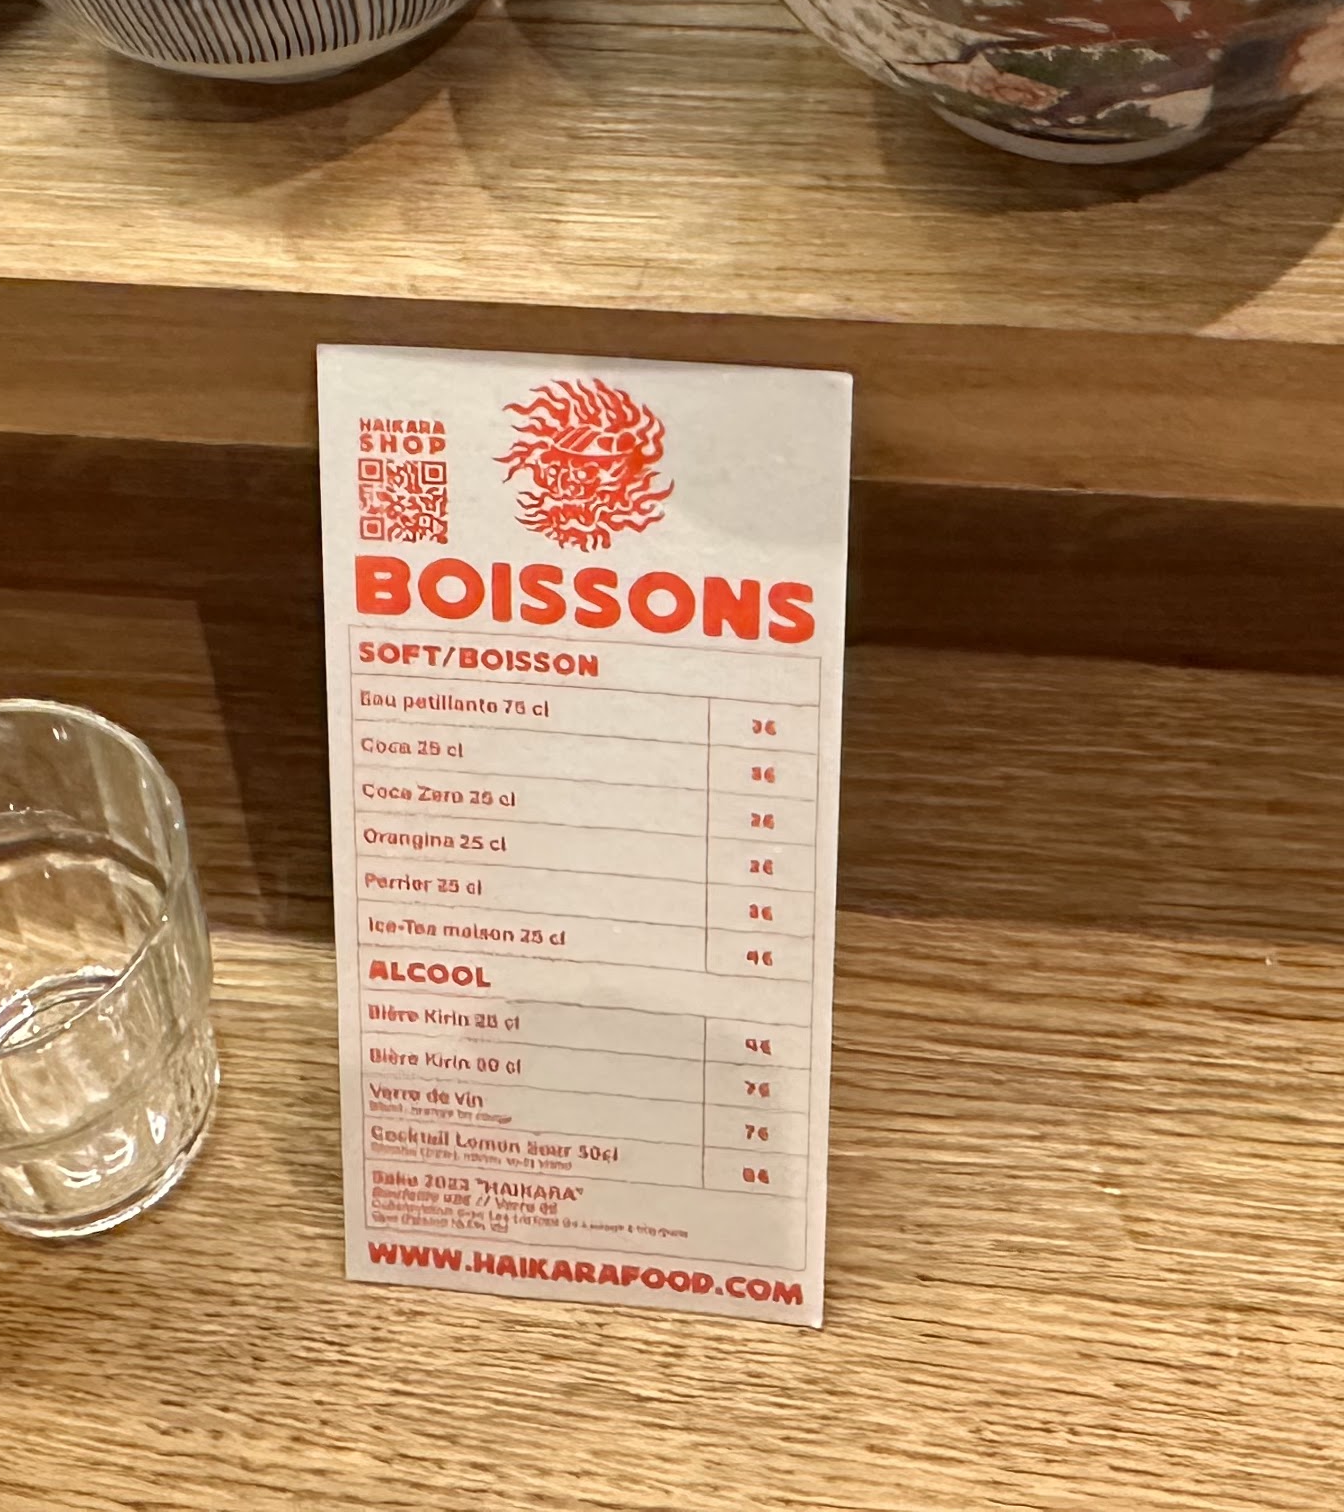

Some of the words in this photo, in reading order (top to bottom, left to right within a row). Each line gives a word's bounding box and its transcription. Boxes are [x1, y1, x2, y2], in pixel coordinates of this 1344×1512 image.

[359, 417, 446, 435] HAIKARA
[359, 434, 446, 455] SHOP
[355, 554, 816, 644] BOISSONS
[358, 641, 600, 678] SOFT/BOISSON
[360, 690, 397, 708] Eau
[532, 700, 550, 718] cl
[360, 737, 412, 755] Coca
[417, 740, 441, 756] 25
[447, 741, 464, 758] cl
[362, 783, 412, 801] Coca
[417, 785, 464, 804] Zero
[499, 791, 516, 808] cl
[363, 828, 456, 850] Orangina
[460, 835, 484, 851] 25
[489, 836, 507, 852] cl
[364, 872, 433, 893] Perrier
[437, 879, 460, 894] 25
[466, 879, 482, 896] cl
[443, 925, 515, 943] maison
[520, 929, 544, 945] 25
[549, 930, 566, 947] cl
[369, 959, 492, 989] ALCOOL
[424, 1008, 470, 1028] Kirin
[504, 1015, 520, 1031] cl
[424, 1051, 471, 1071] Kirin
[506, 1059, 522, 1075] cl
[369, 1082, 422, 1104] Verre
[427, 1088, 451, 1104] de
[370, 1124, 451, 1147] Cocktail
[455, 1133, 522, 1155] Lemon
[368, 1241, 804, 1306] WWW.HAIKARAFOOD.COM
